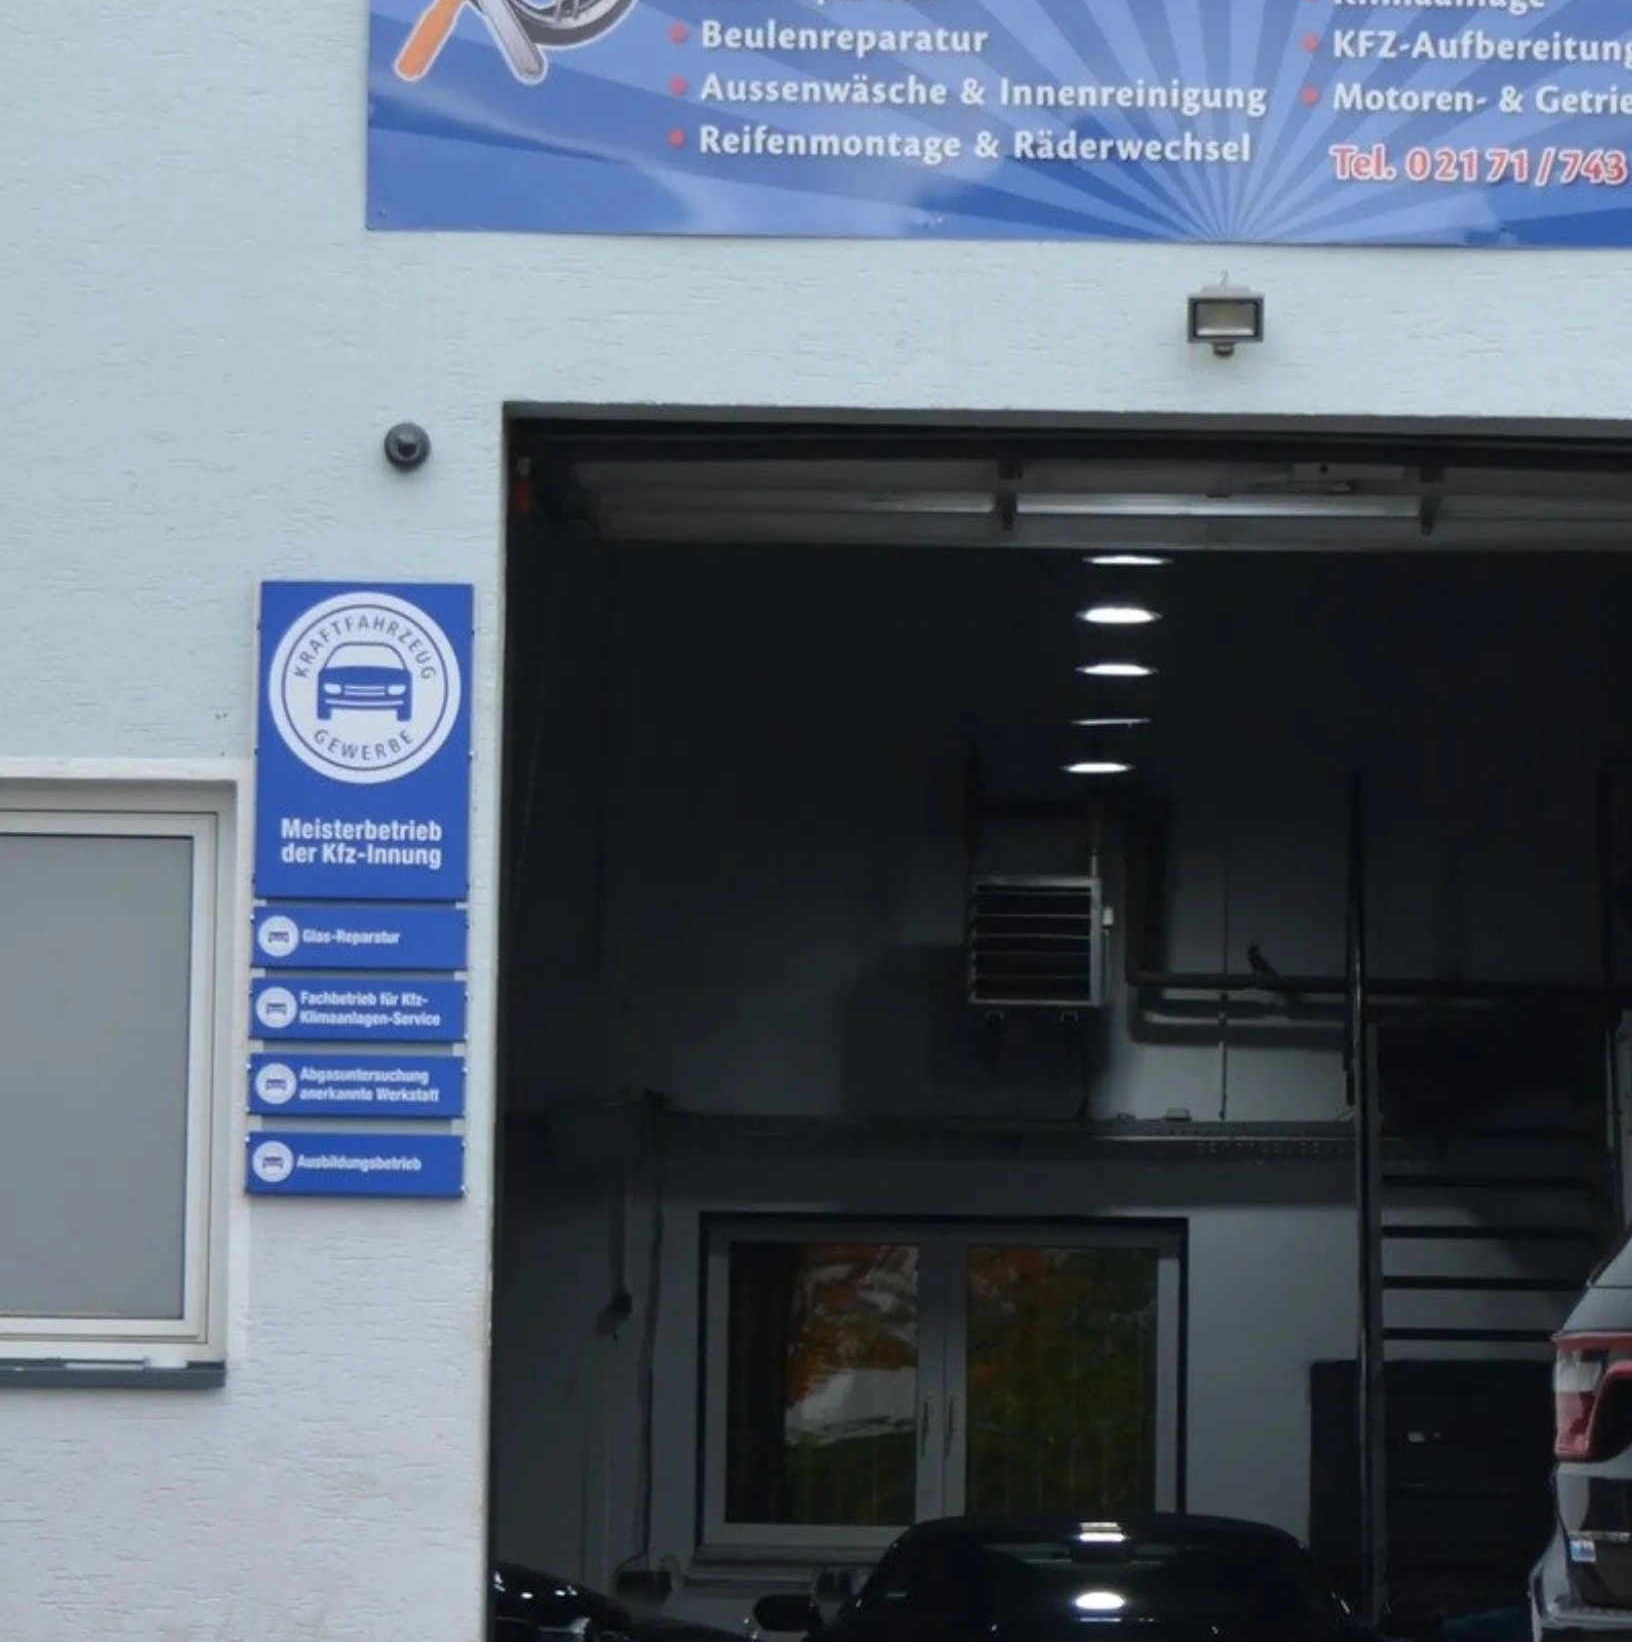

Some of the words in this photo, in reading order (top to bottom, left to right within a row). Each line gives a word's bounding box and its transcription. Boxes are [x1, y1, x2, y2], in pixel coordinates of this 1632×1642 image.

[701, 20, 989, 57] Beulenreparatur
[701, 73, 947, 106] Aussenwäsche
[961, 78, 986, 107] &
[1000, 77, 1268, 118] Innenreinigung
[1332, 83, 1488, 114] Motoren-
[1499, 85, 1524, 114] &
[700, 126, 962, 163] Reifenmontage
[974, 132, 999, 160] &
[1013, 129, 1252, 162] Räderwechsel
[1329, 143, 1398, 181] Tel.
[294, 614, 437, 681] KRAFTFAHRZEUG
[313, 727, 414, 762] GEWERBE
[281, 817, 443, 843] Meisterbetrieb
[281, 842, 318, 865] der
[321, 843, 443, 871] Kfz-Innung
[302, 928, 401, 947] Glas-Reparatur
[300, 989, 377, 1007] Fachbetrieb
[300, 1009, 442, 1029] Klimaanlagen-Service
[299, 1066, 430, 1086] Abgasuntersuchung
[375, 1087, 441, 1103] Werkstatt
[296, 1153, 423, 1173] Ausbildungsbetrieb
